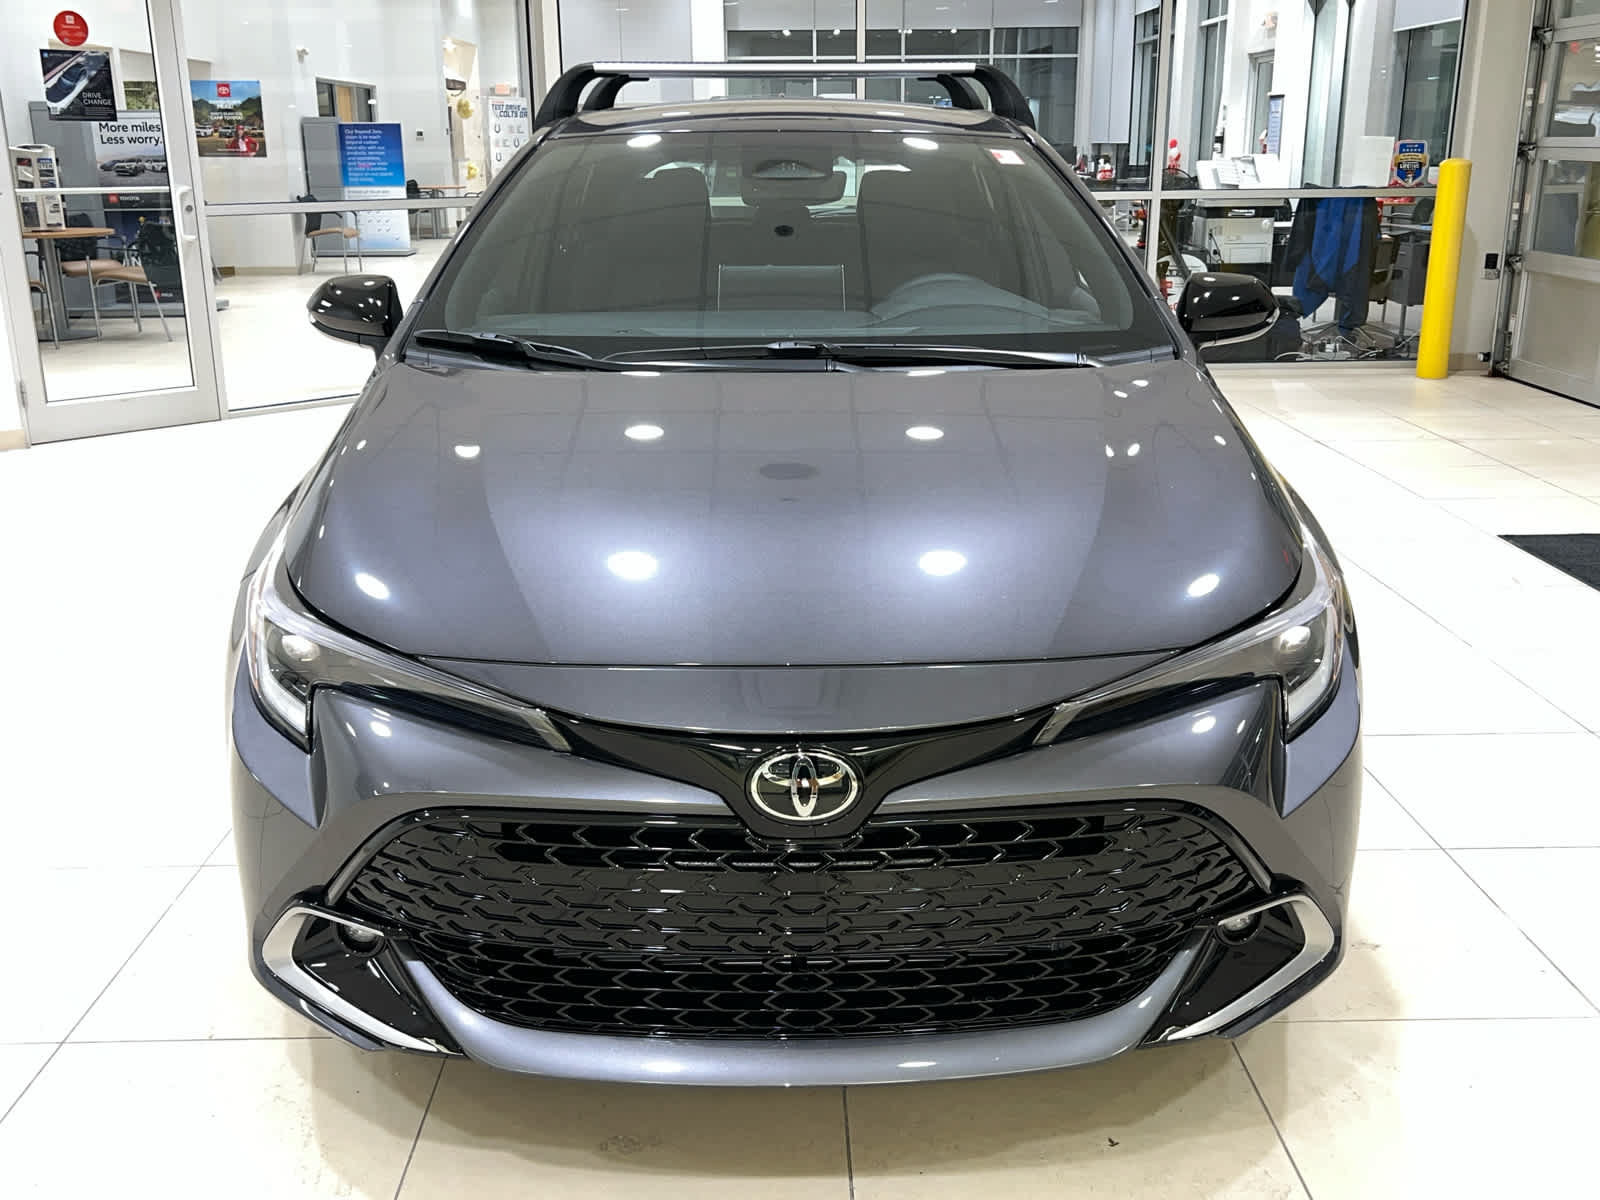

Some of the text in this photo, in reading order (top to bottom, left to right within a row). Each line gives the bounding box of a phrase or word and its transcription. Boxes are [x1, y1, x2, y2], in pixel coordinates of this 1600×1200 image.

[99, 121, 161, 132] More miles
[100, 134, 162, 146] Less worry.
